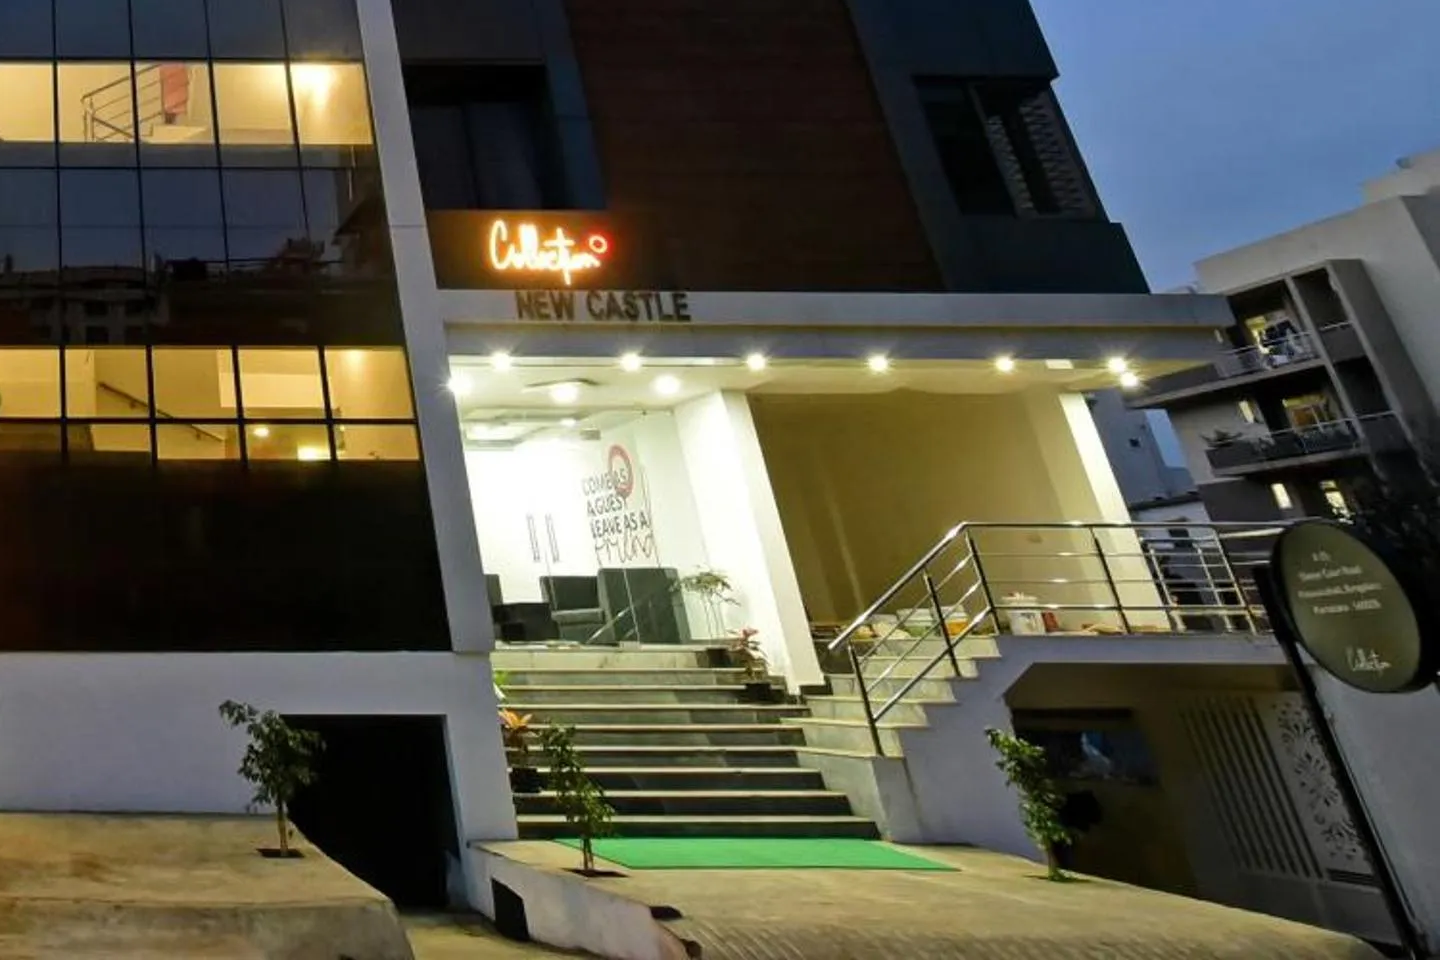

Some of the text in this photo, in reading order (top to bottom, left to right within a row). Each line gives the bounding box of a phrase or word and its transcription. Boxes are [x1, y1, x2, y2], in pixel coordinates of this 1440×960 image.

[515, 289, 692, 322] NEW CASTLE
[581, 473, 613, 496] COME
[589, 516, 622, 539] LEAVE
[623, 511, 638, 531] AS
